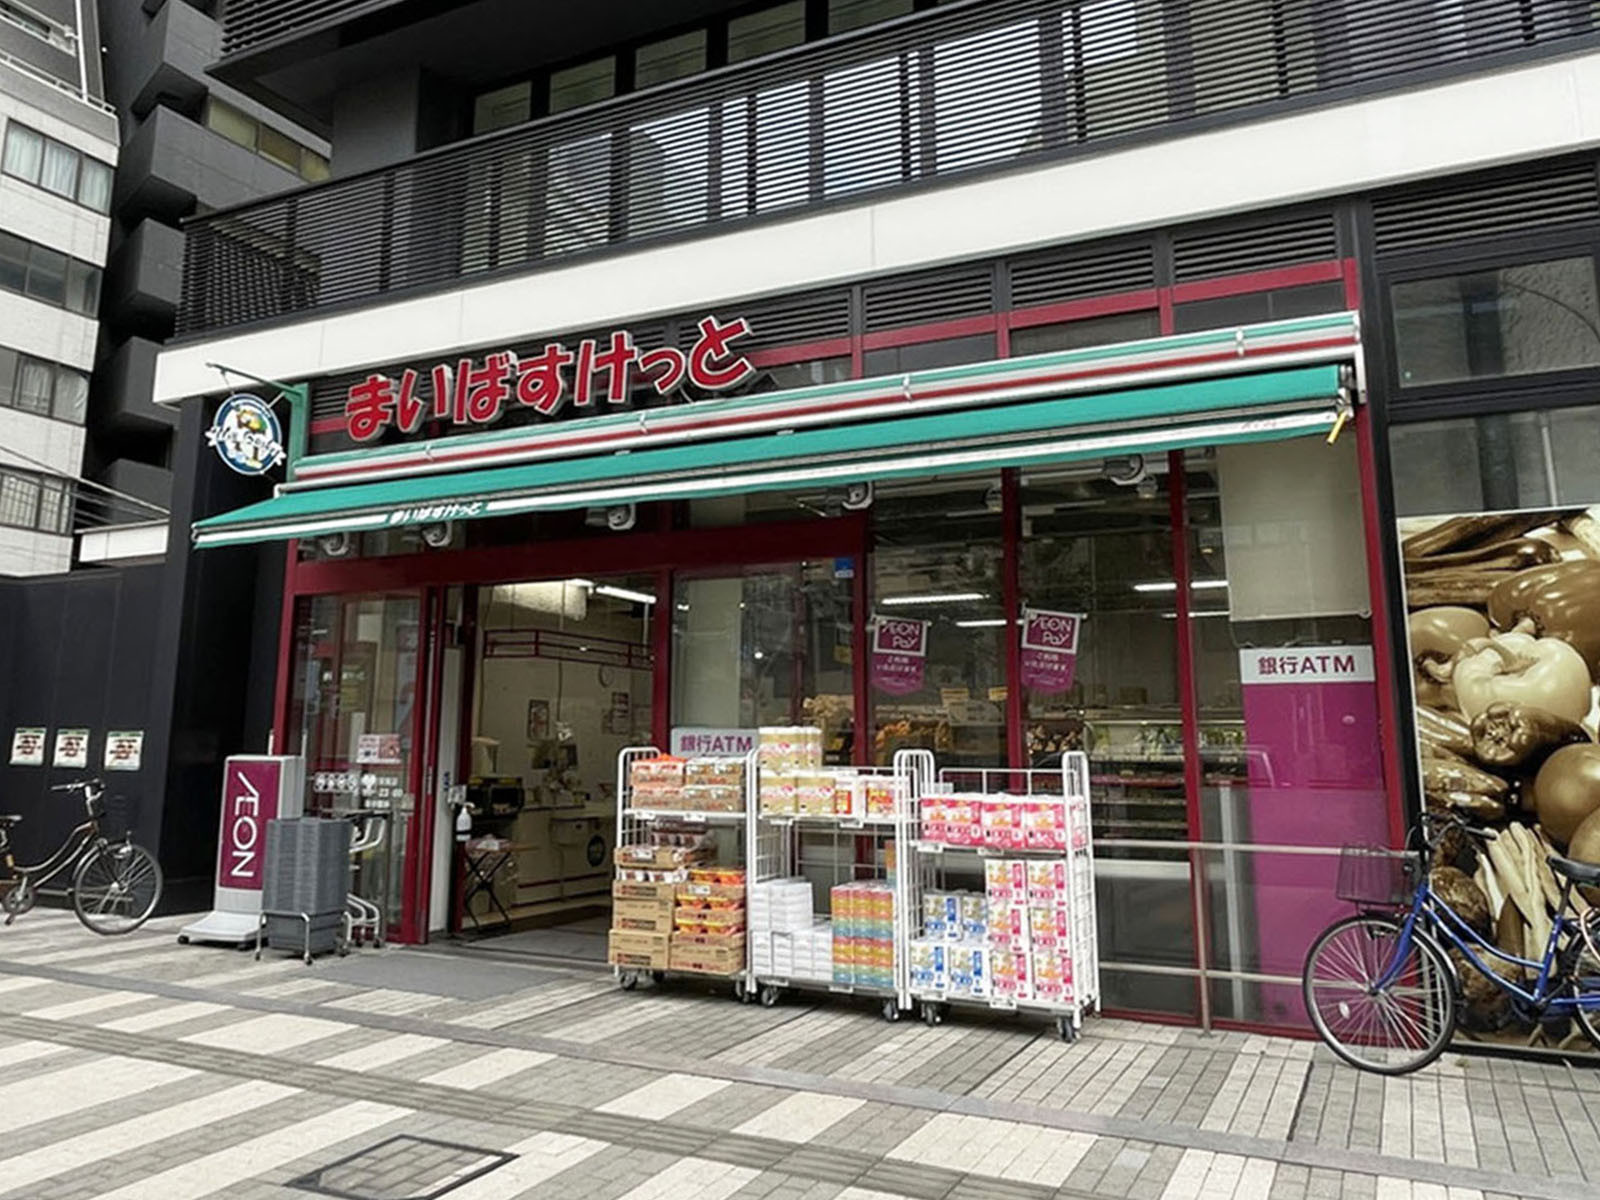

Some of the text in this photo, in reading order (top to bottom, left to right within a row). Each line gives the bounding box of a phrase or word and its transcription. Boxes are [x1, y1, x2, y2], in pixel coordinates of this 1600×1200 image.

[345, 315, 752, 442] まいばすけっと
[1257, 655, 1355, 675] 銀行ATM
[679, 734, 753, 752] 銀行ATM
